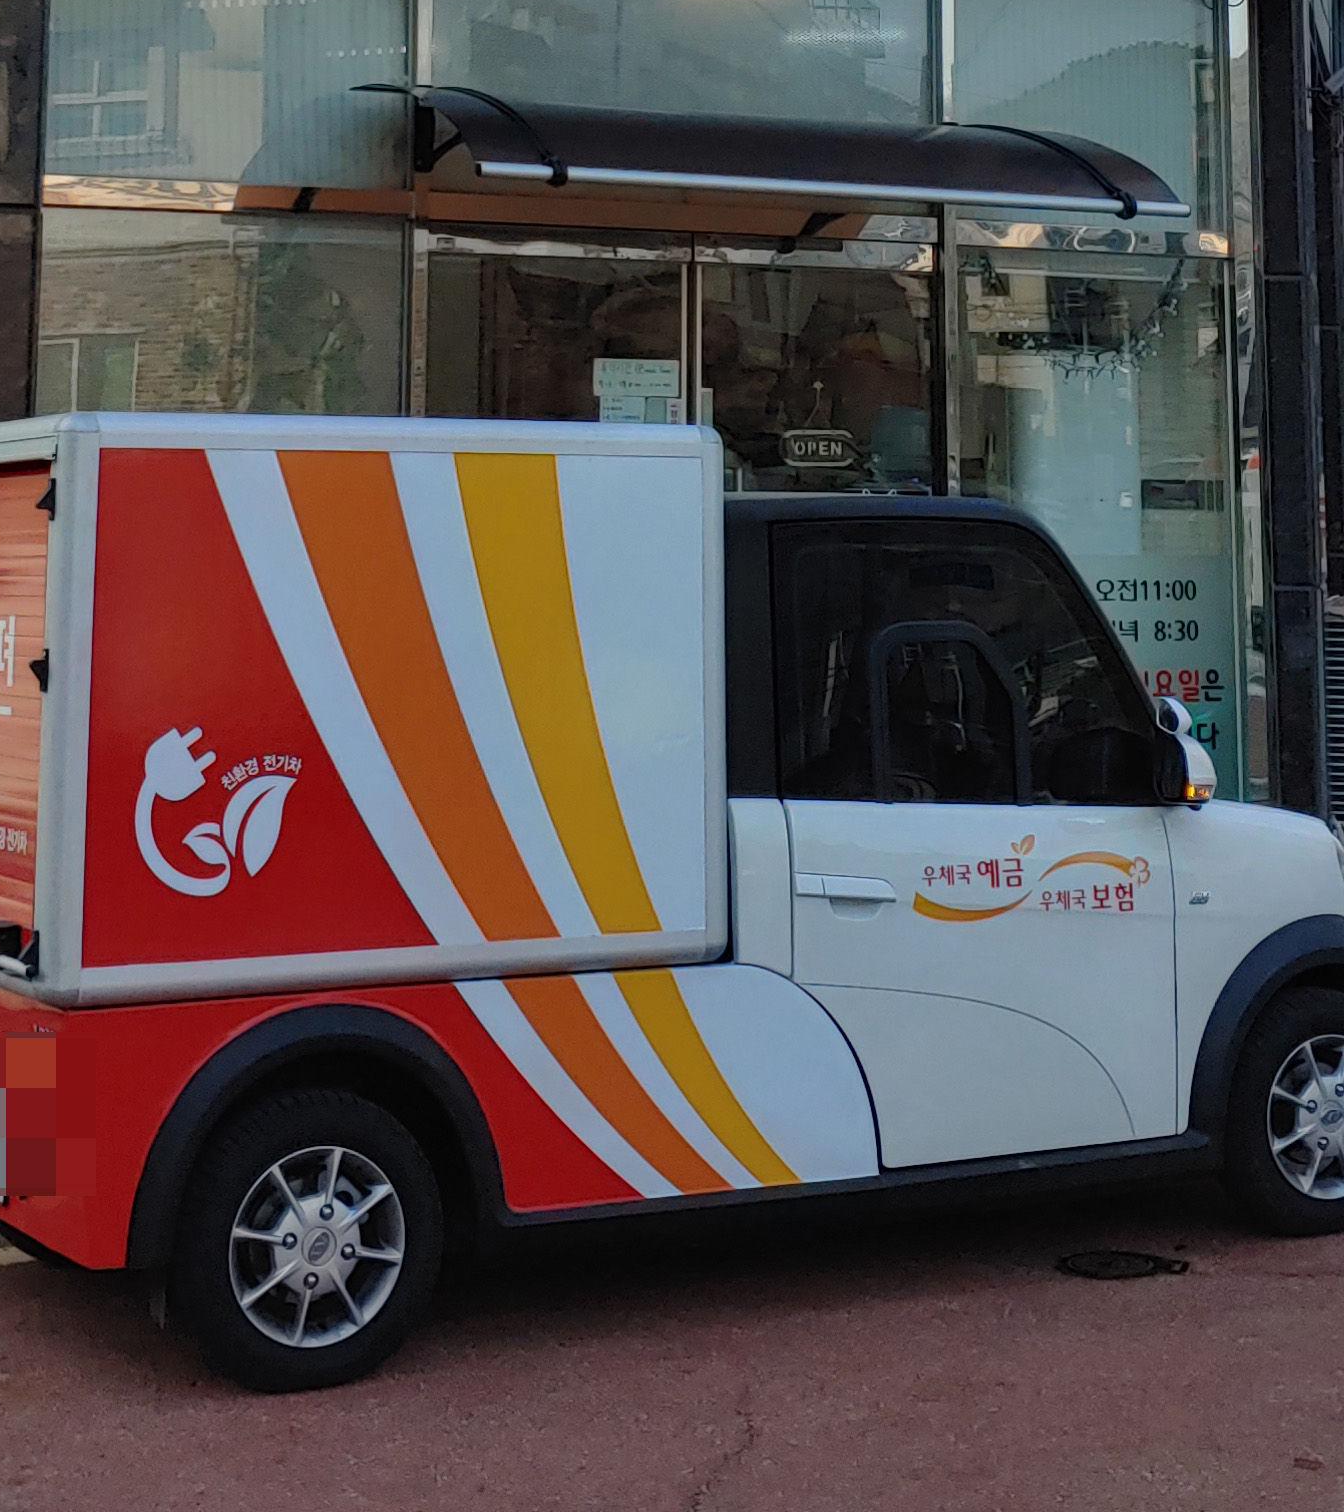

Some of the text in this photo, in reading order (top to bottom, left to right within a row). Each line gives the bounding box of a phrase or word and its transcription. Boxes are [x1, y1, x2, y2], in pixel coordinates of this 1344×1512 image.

[794, 441, 843, 457] OPEN
[1154, 619, 1199, 642] 8:30
[1144, 669, 1225, 703] 요일은
[220, 753, 302, 791] 친환경 전기차
[922, 857, 1025, 889] 우체국 예금
[1038, 882, 1135, 913] 우체국 보험
